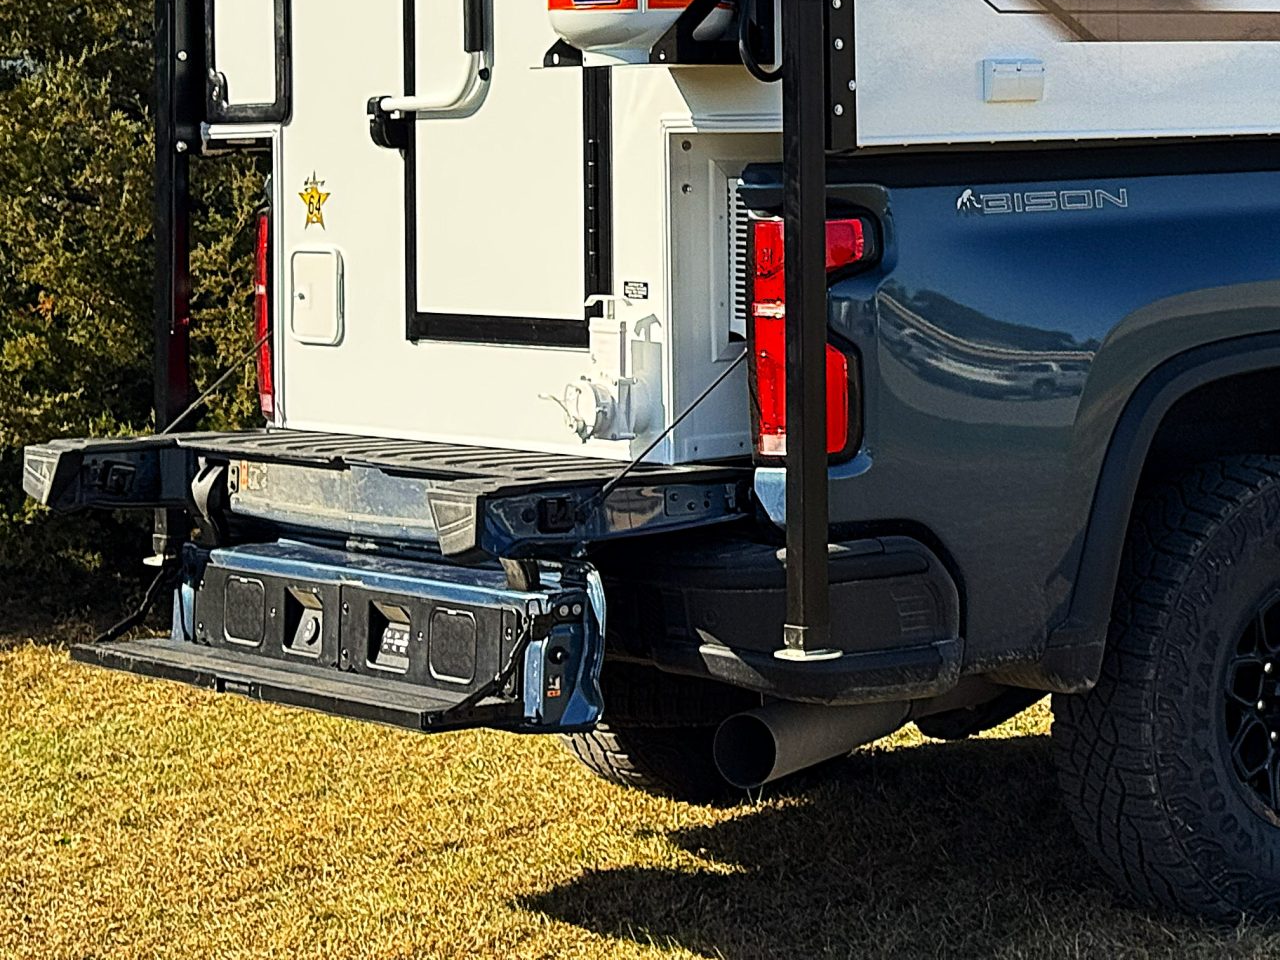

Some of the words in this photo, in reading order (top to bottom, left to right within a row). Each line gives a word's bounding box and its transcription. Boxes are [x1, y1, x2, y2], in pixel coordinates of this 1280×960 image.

[308, 194, 321, 215] 64
[980, 189, 1128, 214] BISON
[1192, 629, 1252, 853] GOODYEAR
